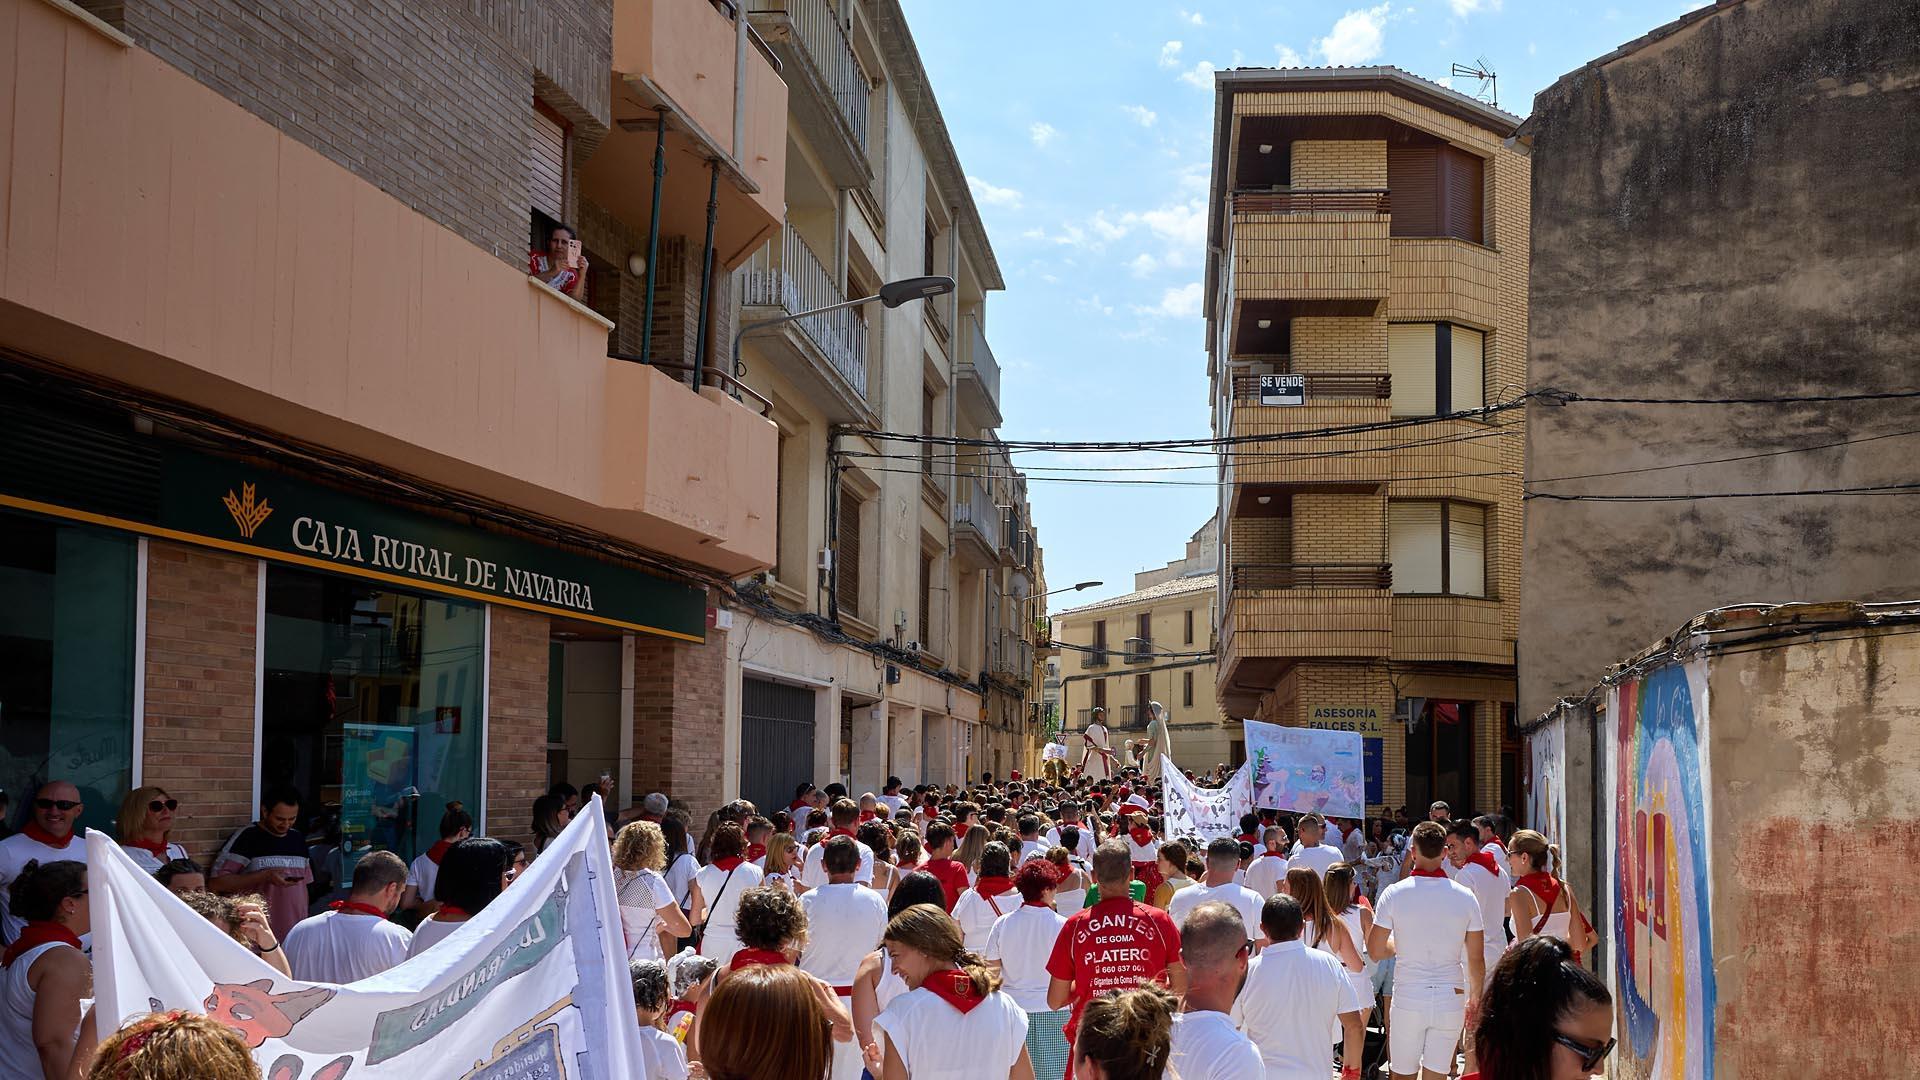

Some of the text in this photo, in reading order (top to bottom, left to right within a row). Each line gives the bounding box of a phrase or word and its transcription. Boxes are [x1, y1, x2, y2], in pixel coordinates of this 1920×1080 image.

[1261, 376, 1303, 387] SE VENDE
[292, 516, 595, 612] CAJA RURAL DE NAVARRA
[1310, 721, 1382, 731] FALCES S.L.
[1077, 914, 1156, 944] GIGANTES
[1096, 935, 1134, 944] DE GOMA
[1085, 949, 1151, 965] PLATERO
[1094, 977, 1113, 987] Gigantes
[1114, 976, 1119, 984] de
[1120, 975, 1132, 984] Goma
